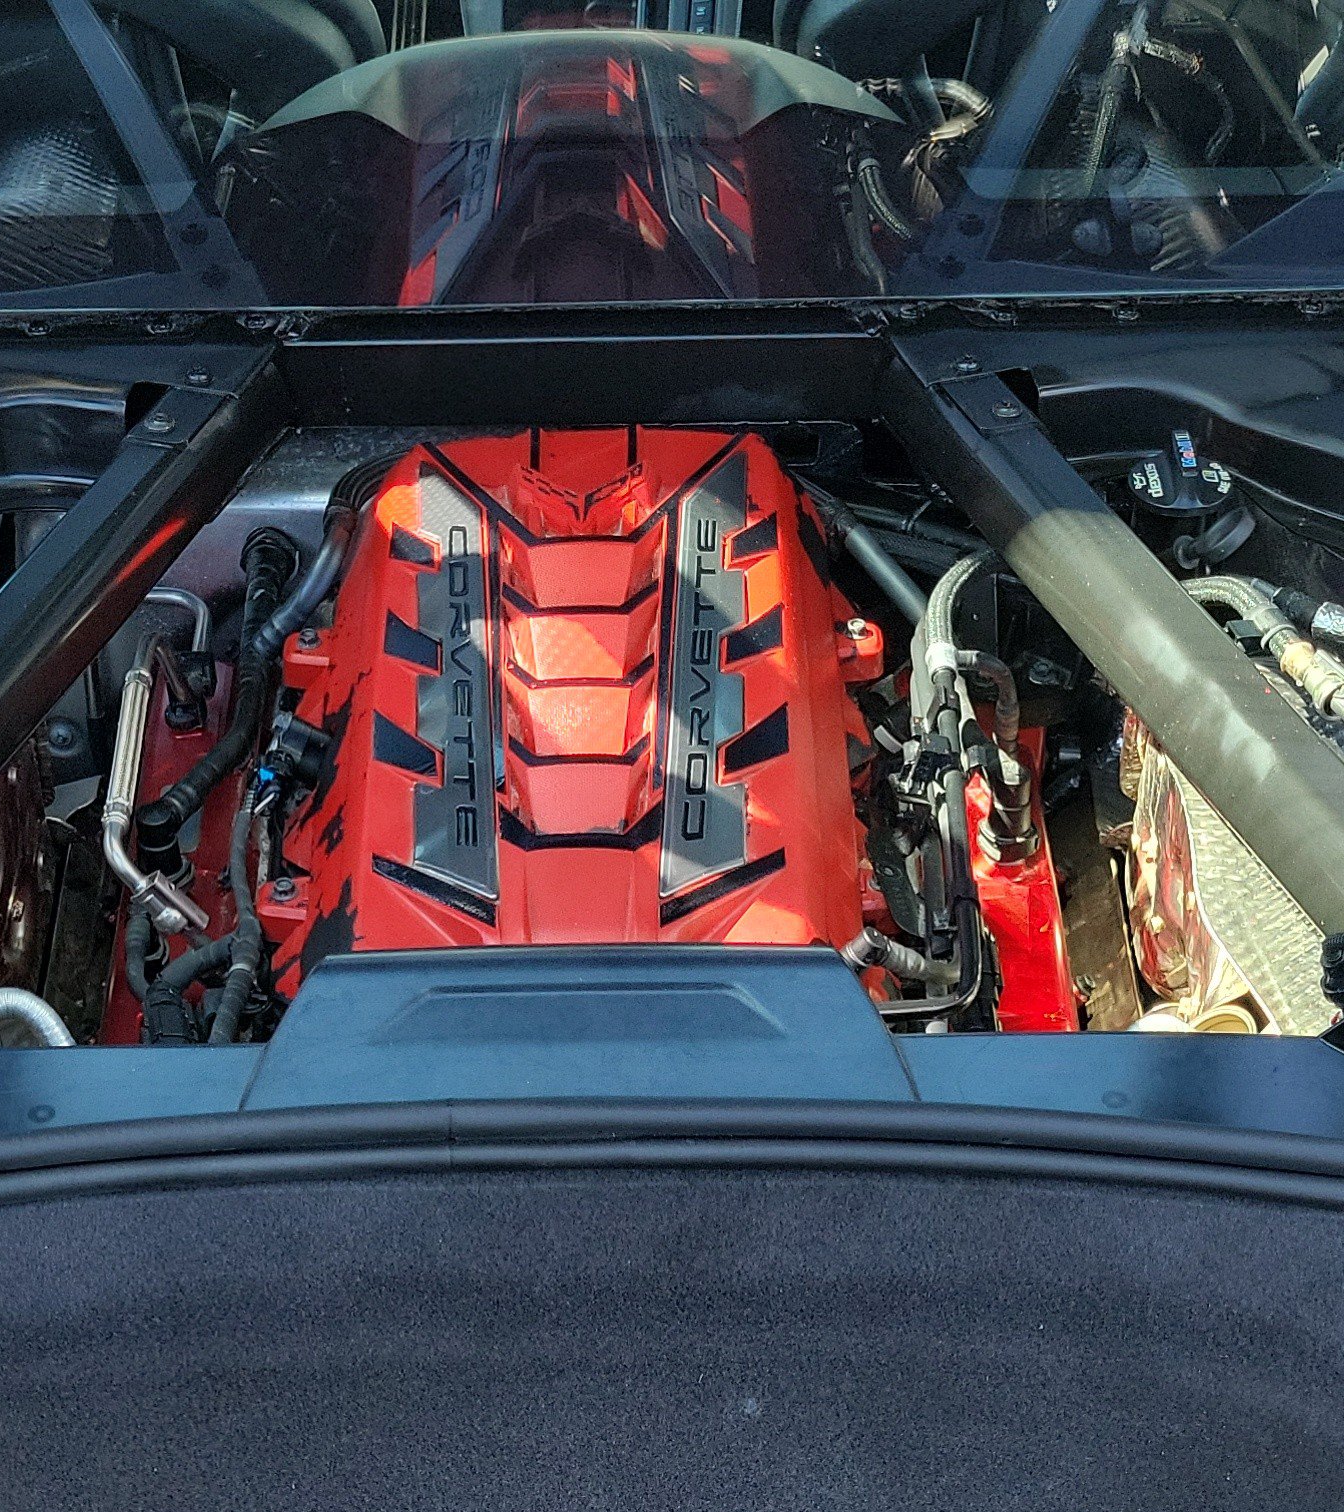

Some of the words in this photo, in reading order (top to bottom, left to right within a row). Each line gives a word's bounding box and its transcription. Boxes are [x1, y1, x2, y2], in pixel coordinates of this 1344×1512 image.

[1144, 463, 1164, 498] dexos
[449, 525, 478, 847] CORVETTE
[681, 518, 717, 841] CORVETTE
